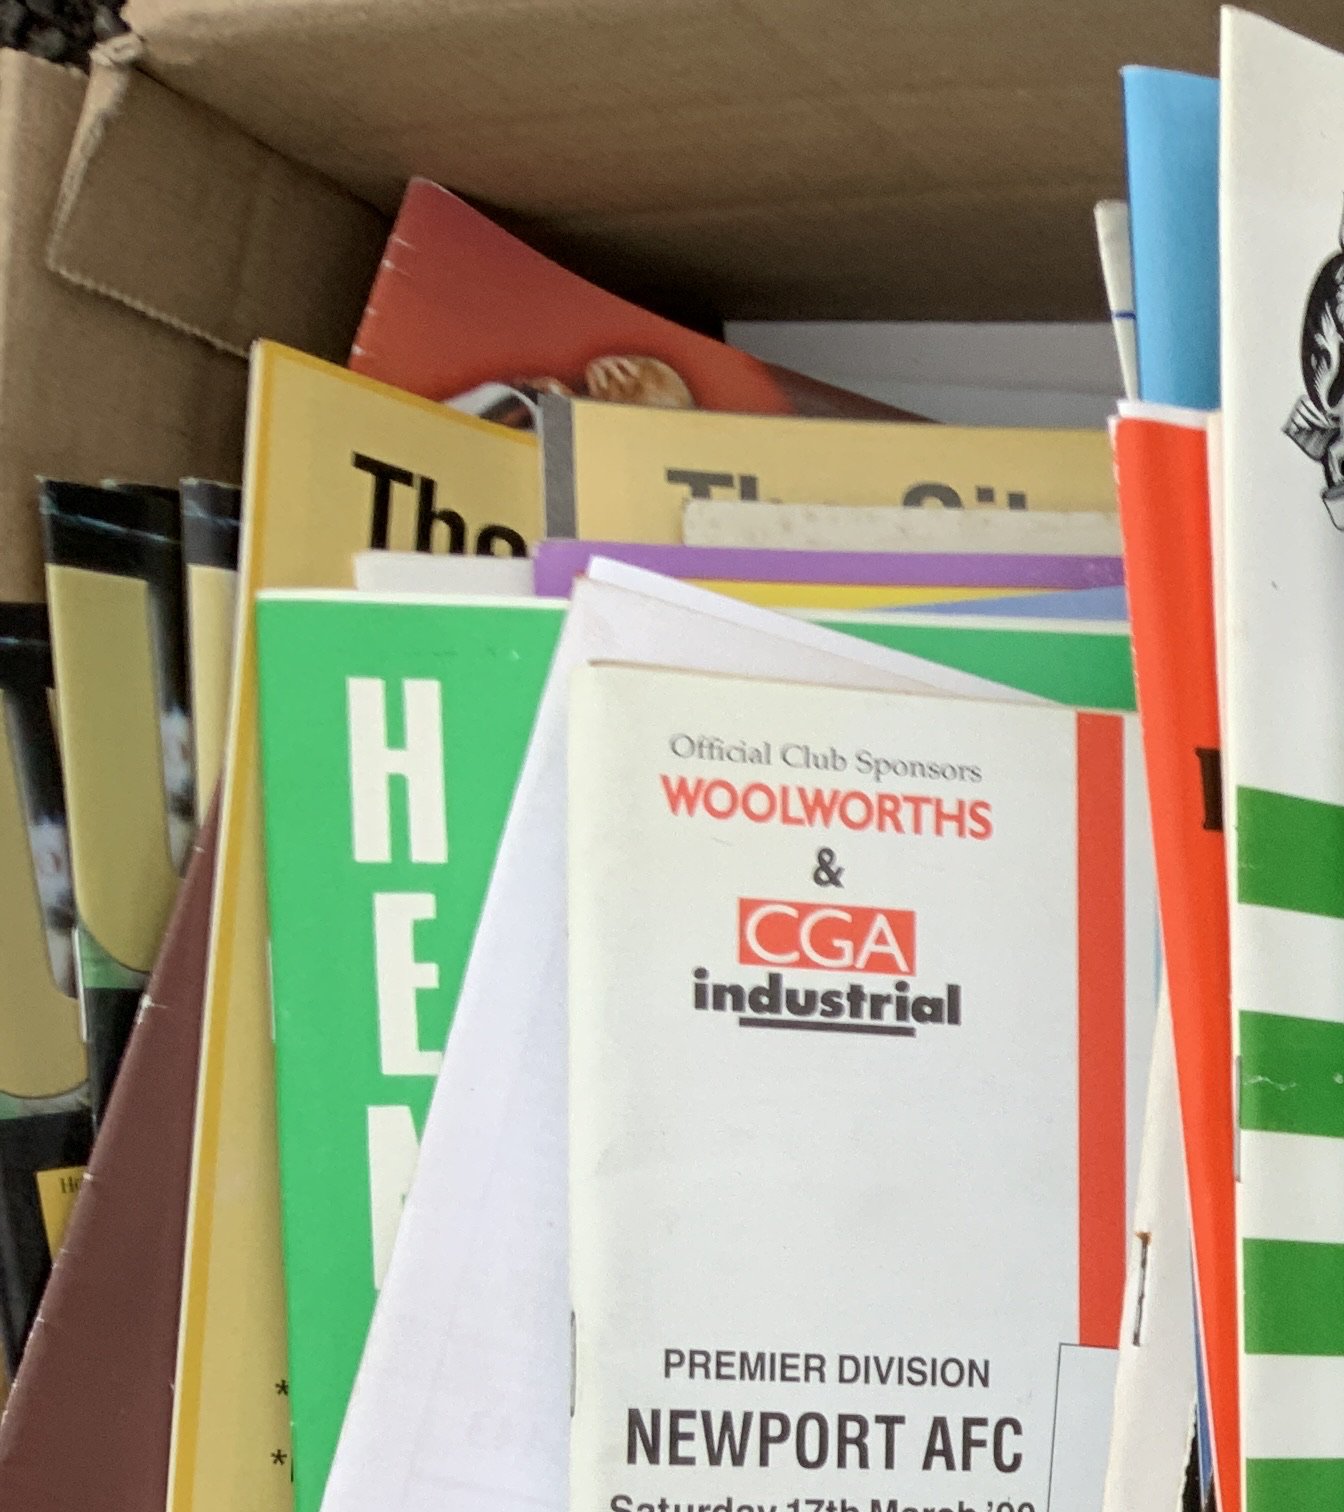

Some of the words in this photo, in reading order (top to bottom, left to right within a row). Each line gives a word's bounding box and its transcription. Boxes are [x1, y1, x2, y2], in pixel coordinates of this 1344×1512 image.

[670, 732, 772, 766] Official
[780, 743, 848, 772] Club
[856, 749, 983, 783] Sponsors
[659, 773, 994, 840] WOOLWORTHS
[812, 847, 845, 888] &
[745, 904, 910, 971] CGA
[694, 968, 962, 1026] industrial
[664, 1347, 827, 1384] PREMIER
[838, 1353, 991, 1388] DIVISION
[626, 1407, 906, 1471] NEWPORT
[922, 1414, 1025, 1474] AFC
